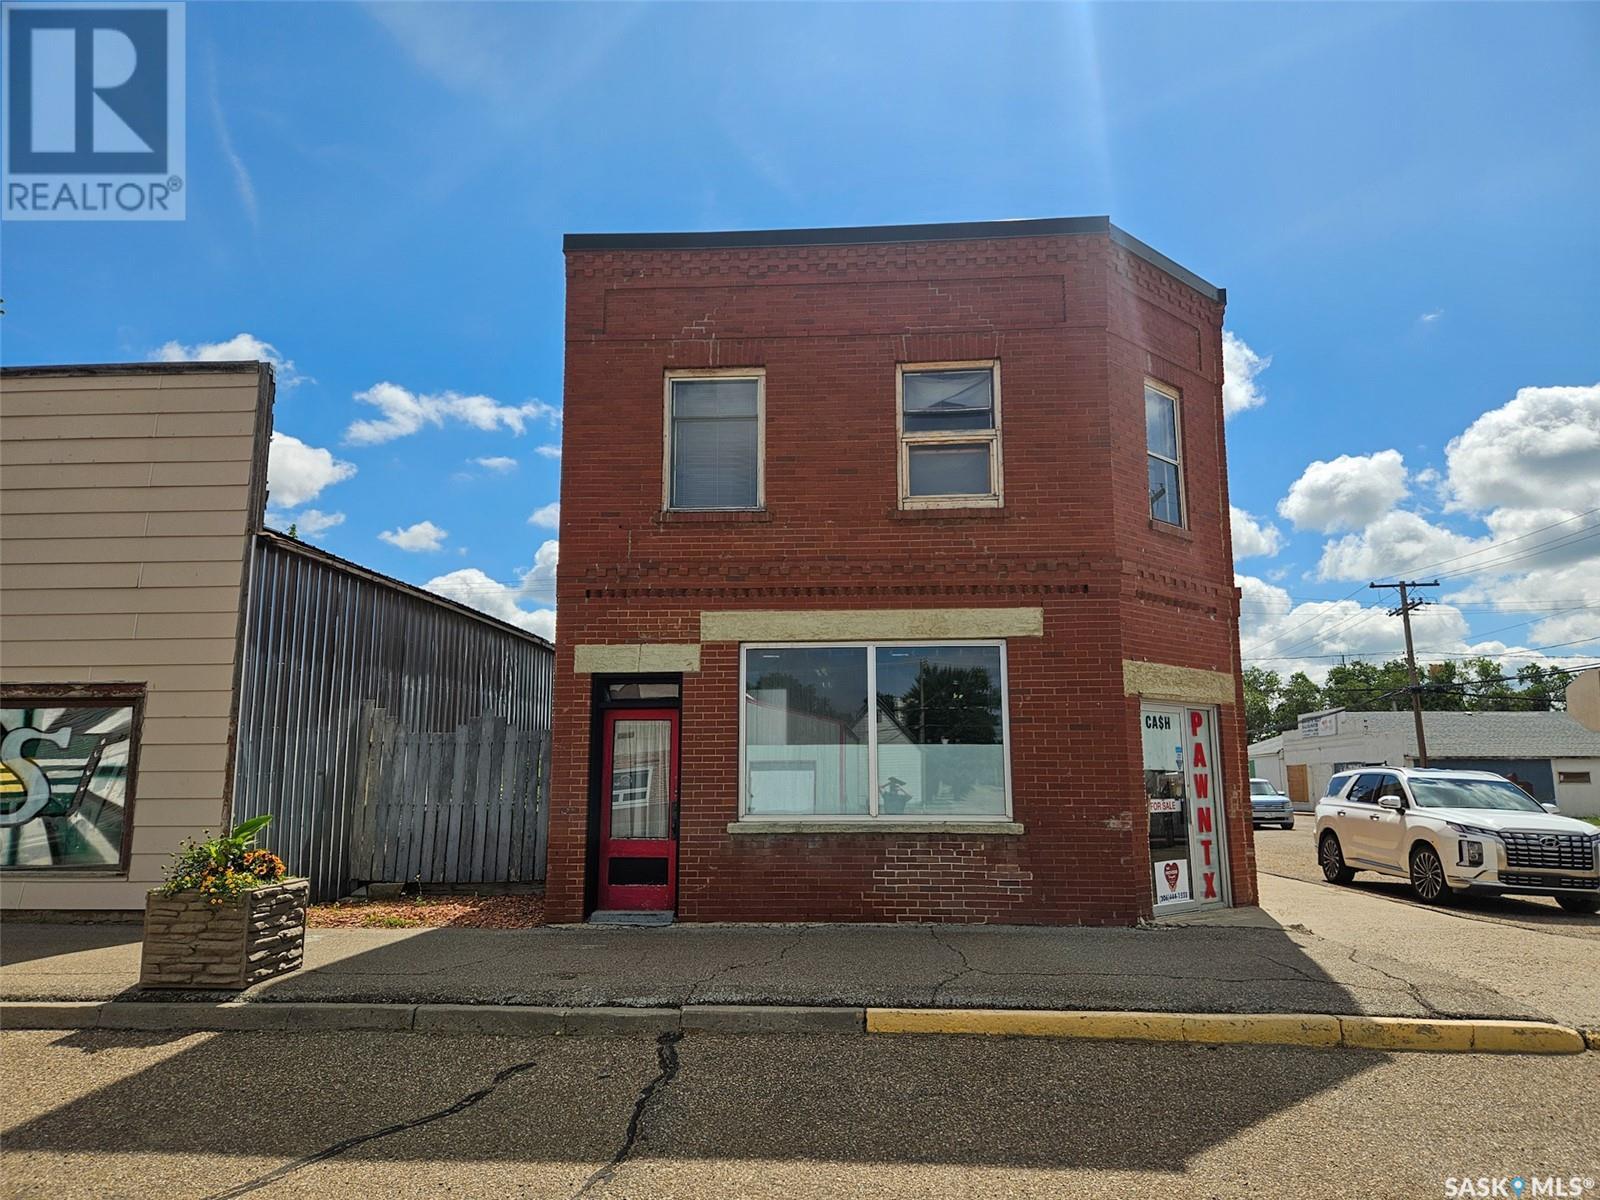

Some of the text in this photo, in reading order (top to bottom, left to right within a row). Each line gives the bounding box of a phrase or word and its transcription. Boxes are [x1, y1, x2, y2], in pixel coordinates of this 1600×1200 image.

[1145, 715, 1171, 730] CA$H
[1150, 801, 1176, 811] FOR SALE
